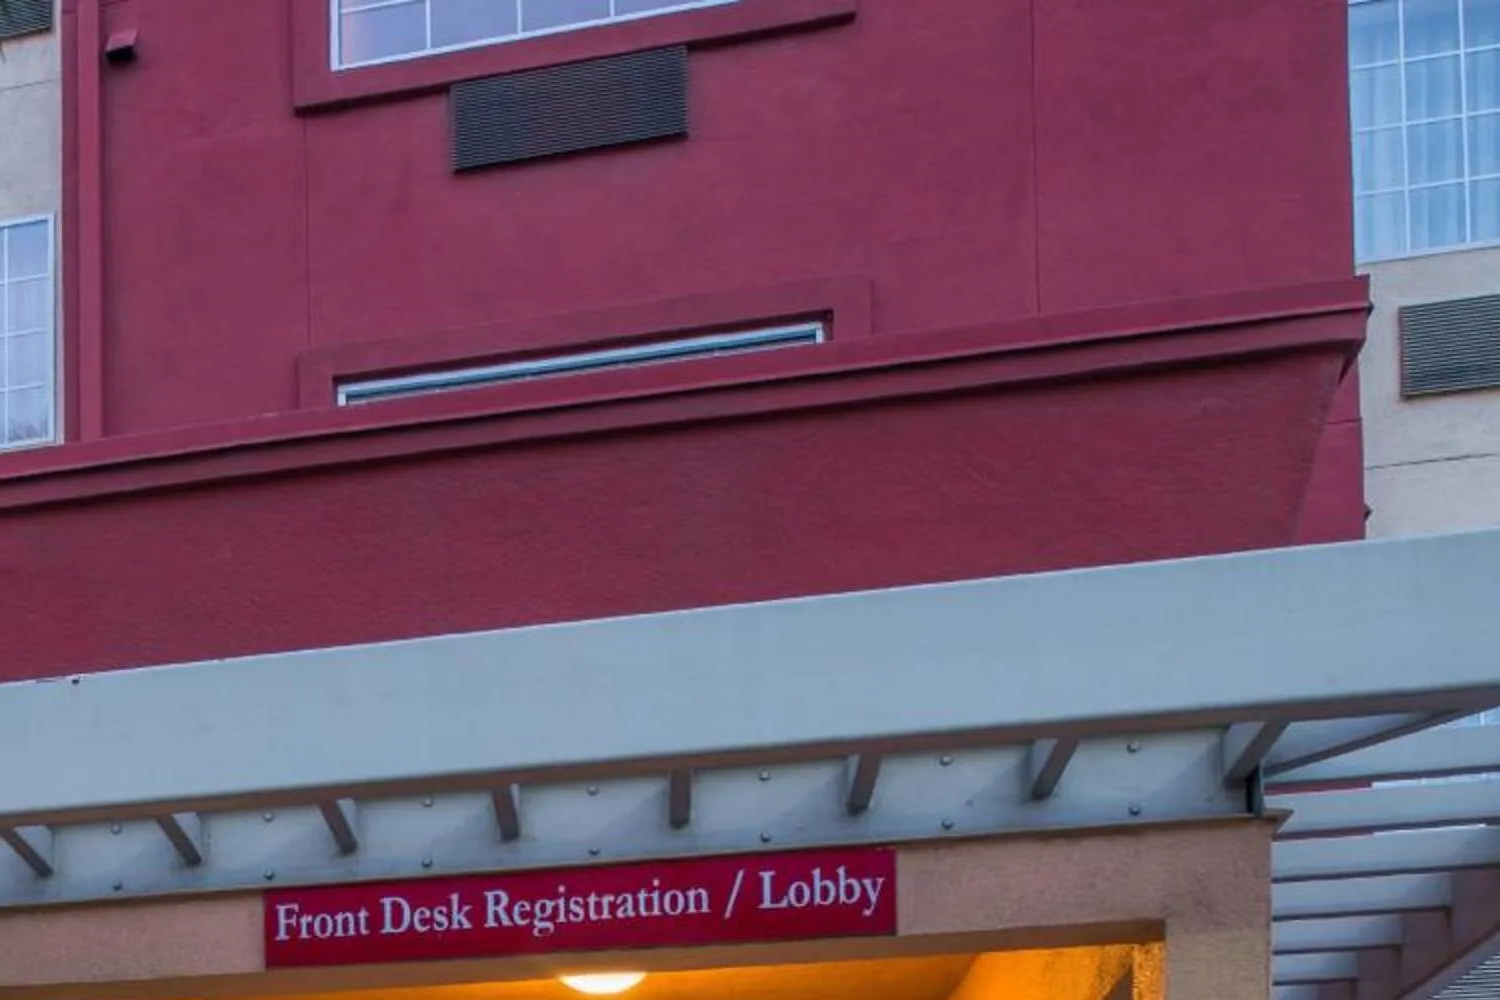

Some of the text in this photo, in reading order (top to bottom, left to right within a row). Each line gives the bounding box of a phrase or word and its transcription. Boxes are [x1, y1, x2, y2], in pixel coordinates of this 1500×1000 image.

[275, 864, 886, 941] Front Desk Registration / Lobby
